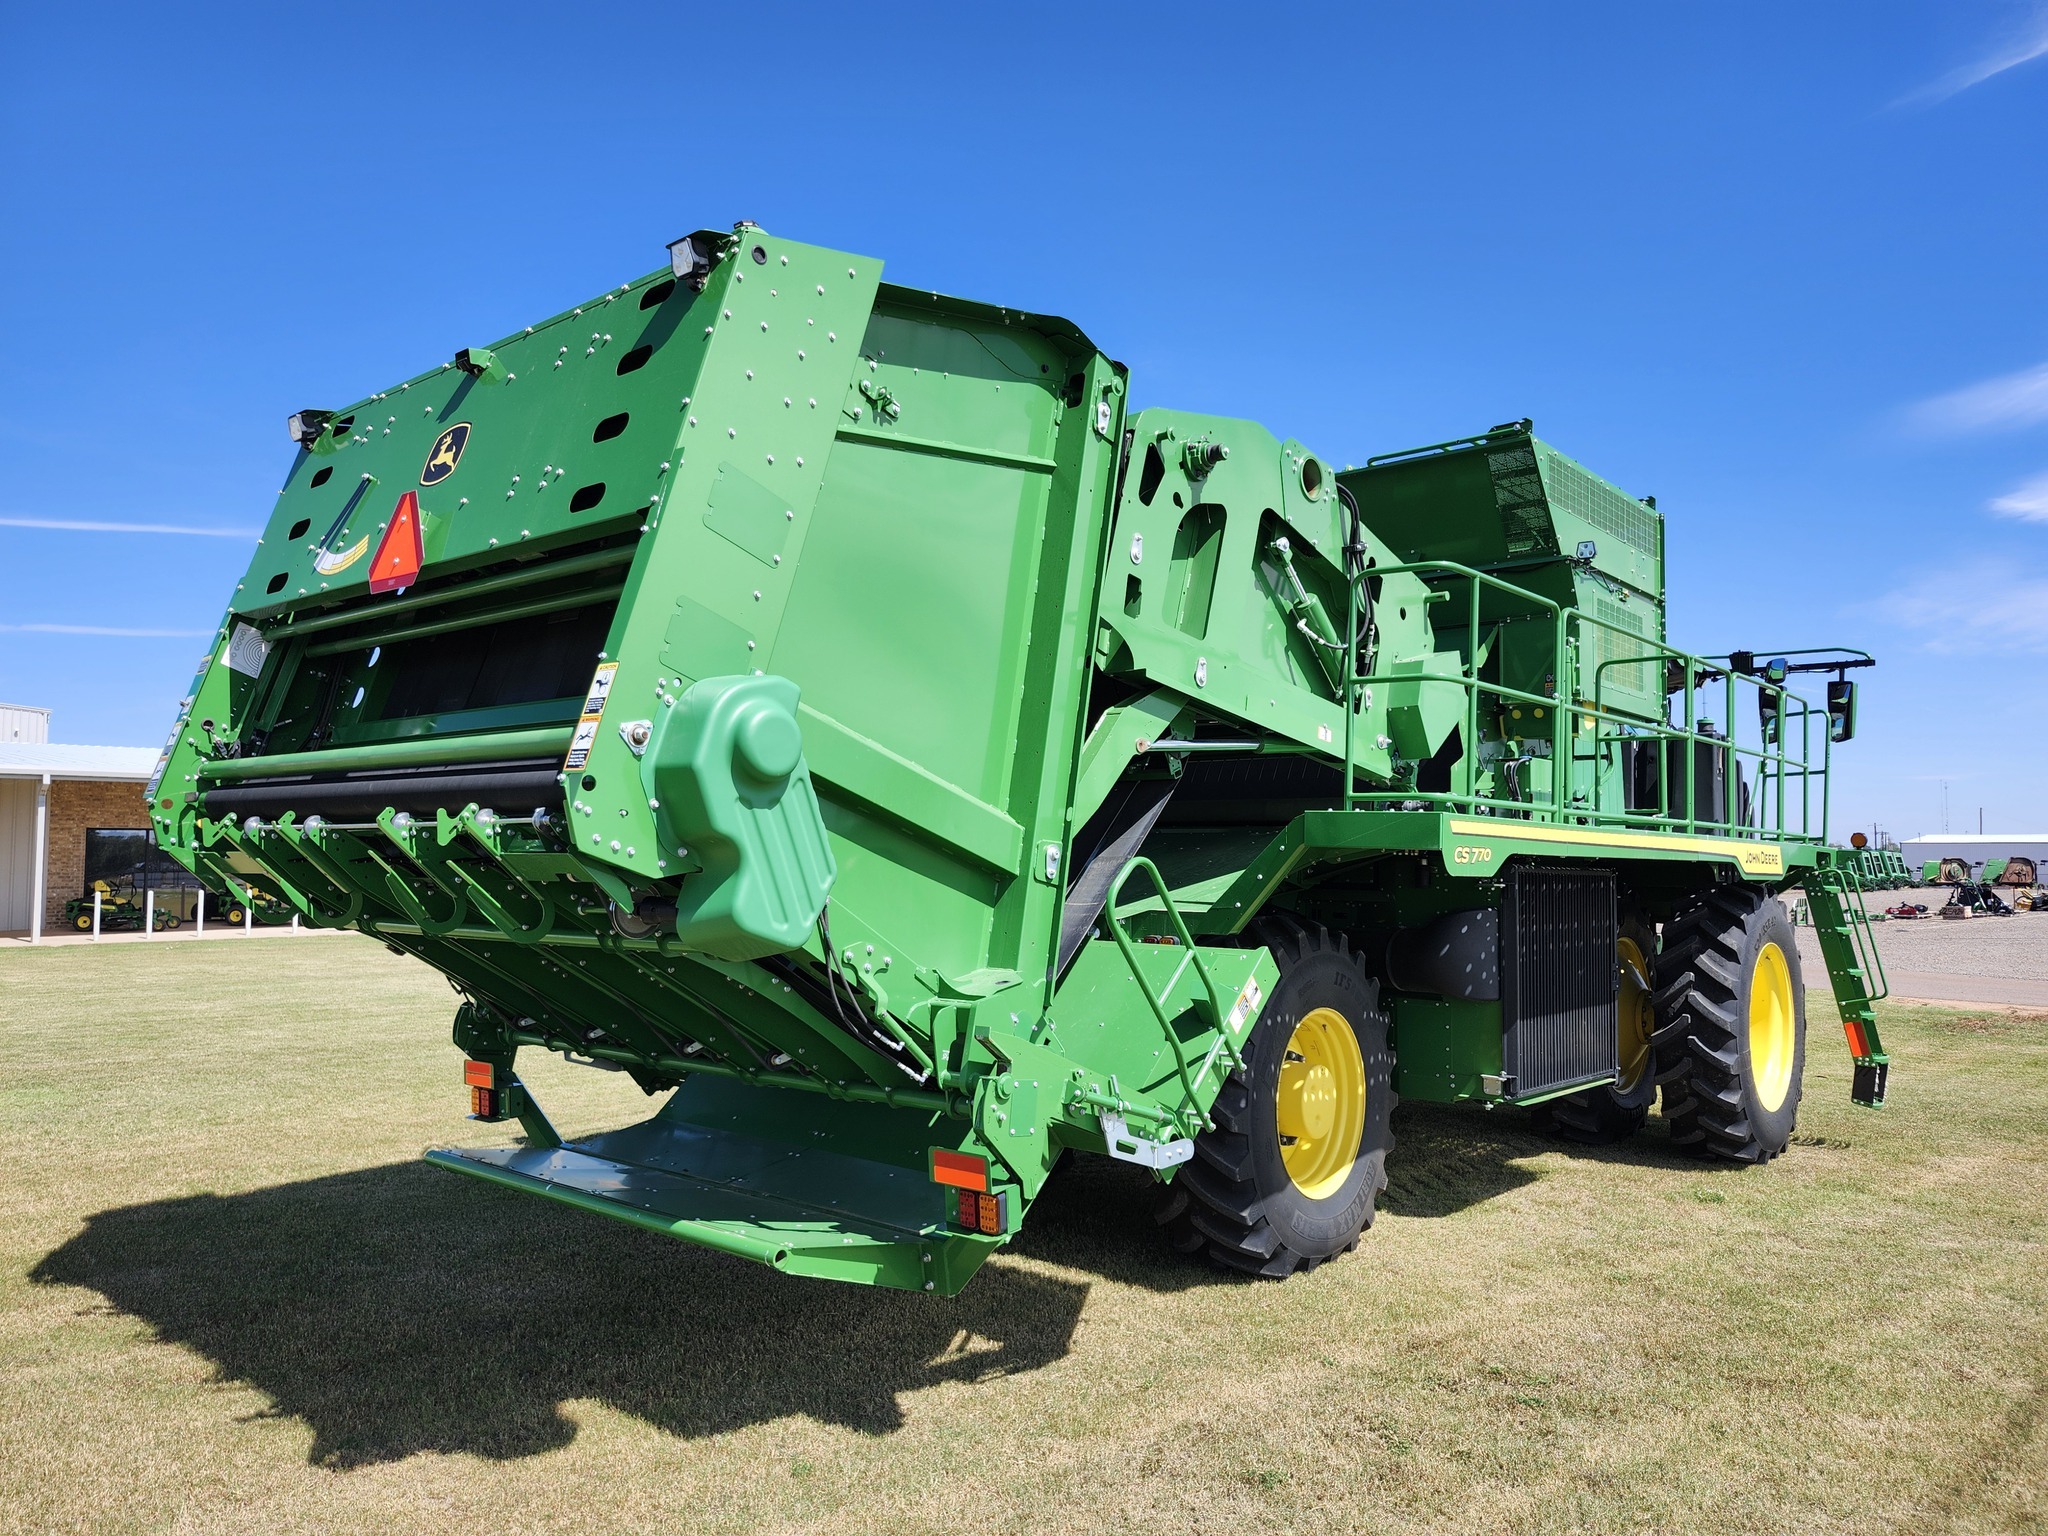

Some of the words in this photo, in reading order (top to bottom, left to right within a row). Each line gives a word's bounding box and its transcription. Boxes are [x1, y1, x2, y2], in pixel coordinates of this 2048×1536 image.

[1454, 846, 1470, 864] CS
[1470, 847, 1492, 864] 770
[1746, 850, 1760, 864] JOHN
[1761, 851, 1778, 865] DEERE
